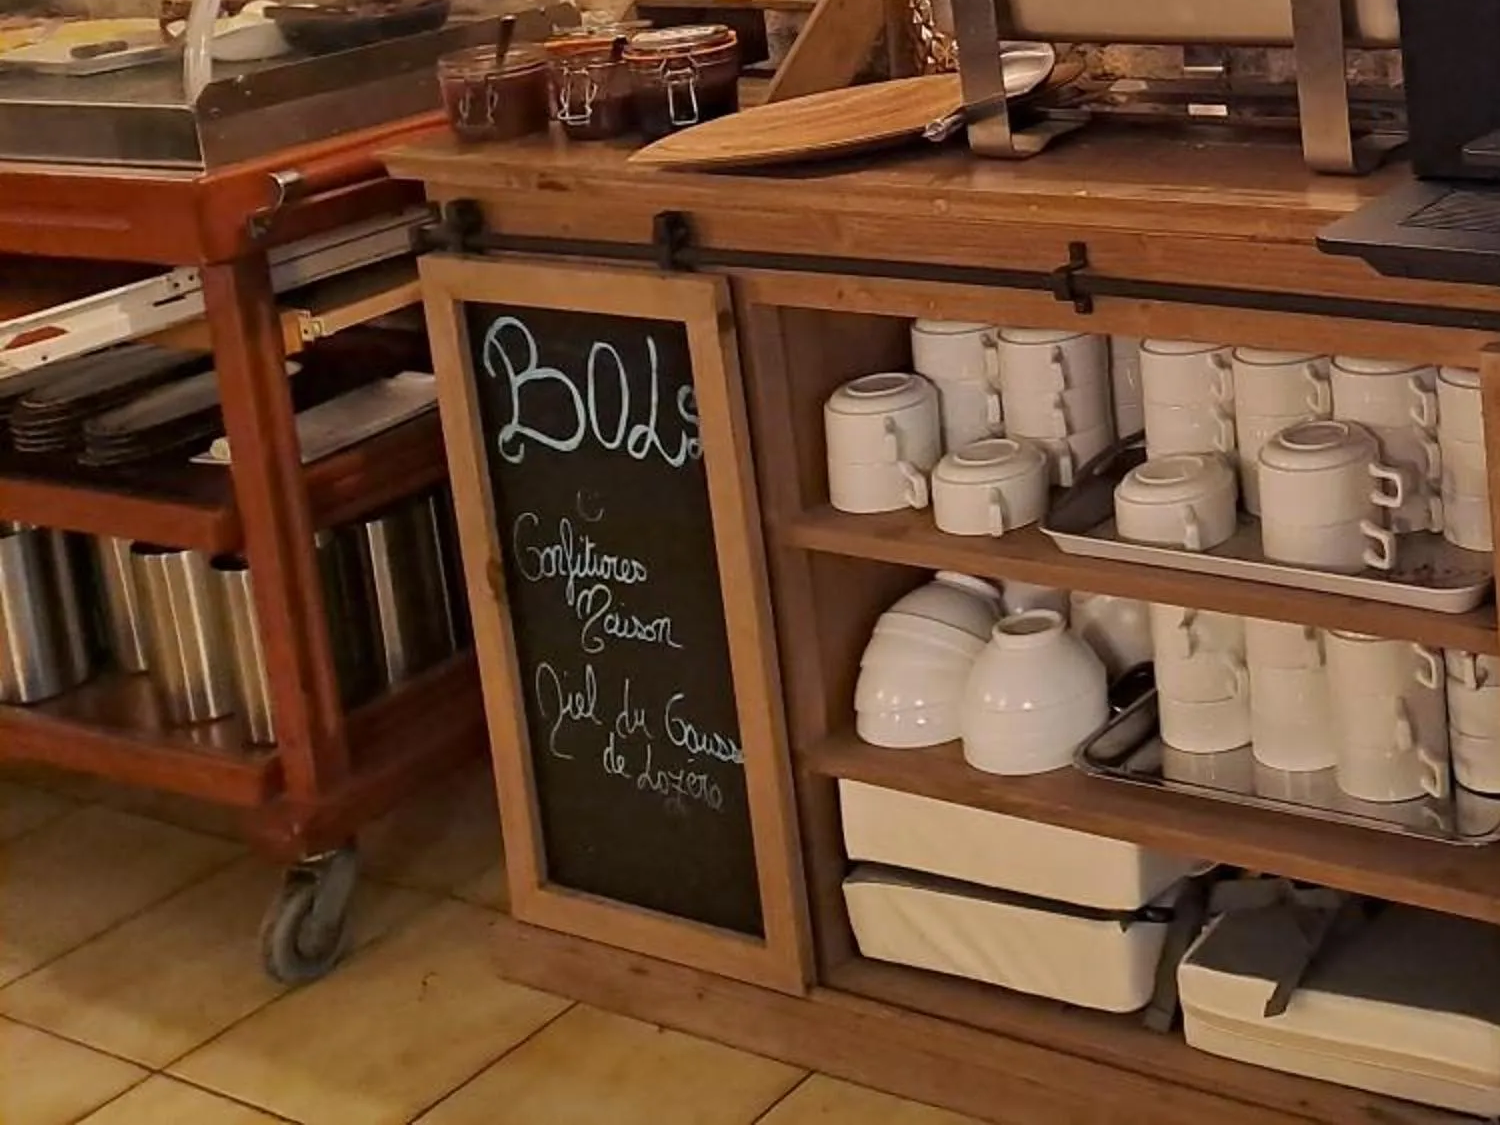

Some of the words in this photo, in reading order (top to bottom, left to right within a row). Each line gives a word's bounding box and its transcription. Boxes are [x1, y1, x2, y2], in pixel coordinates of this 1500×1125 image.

[513, 511, 648, 607] Confitures
[577, 583, 684, 654] Maison
[615, 678, 652, 740] du
[602, 731, 631, 779] de
